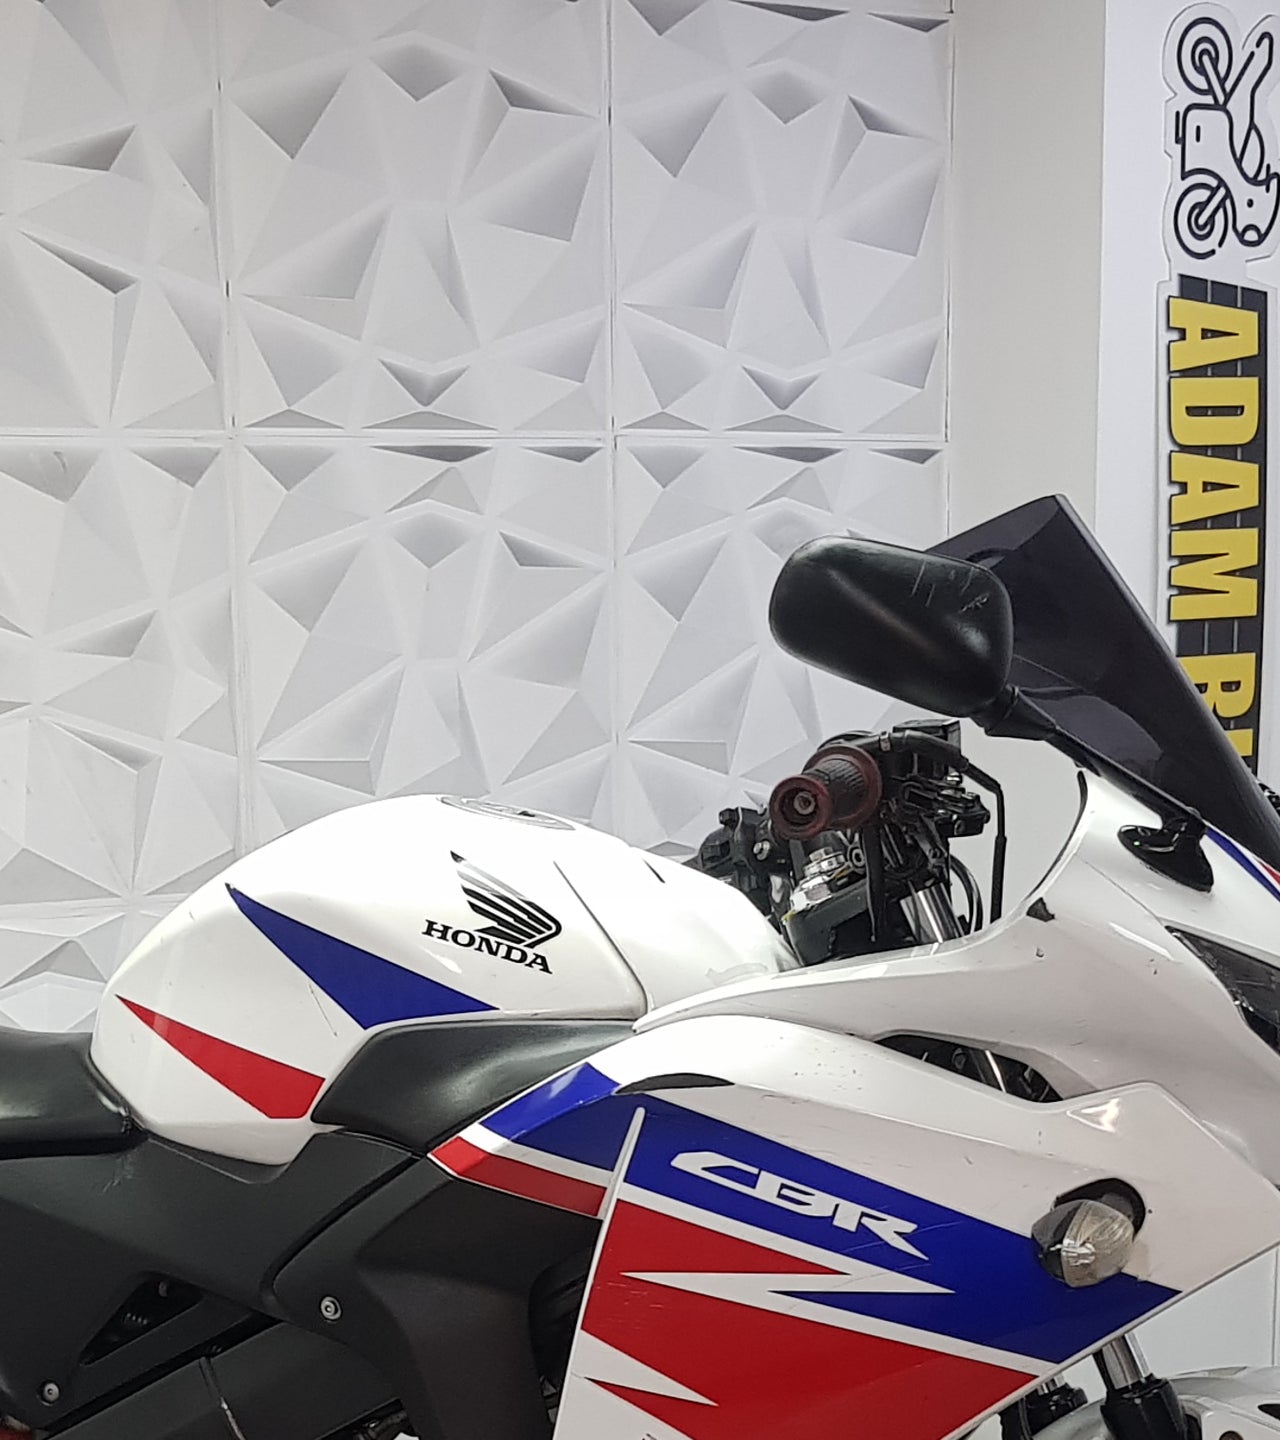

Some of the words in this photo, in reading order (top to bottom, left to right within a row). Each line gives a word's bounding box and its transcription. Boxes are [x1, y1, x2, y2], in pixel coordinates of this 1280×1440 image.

[1167, 295, 1260, 622] ADAM
[421, 919, 553, 975] HONDA
[670, 1151, 929, 1260] CBR
